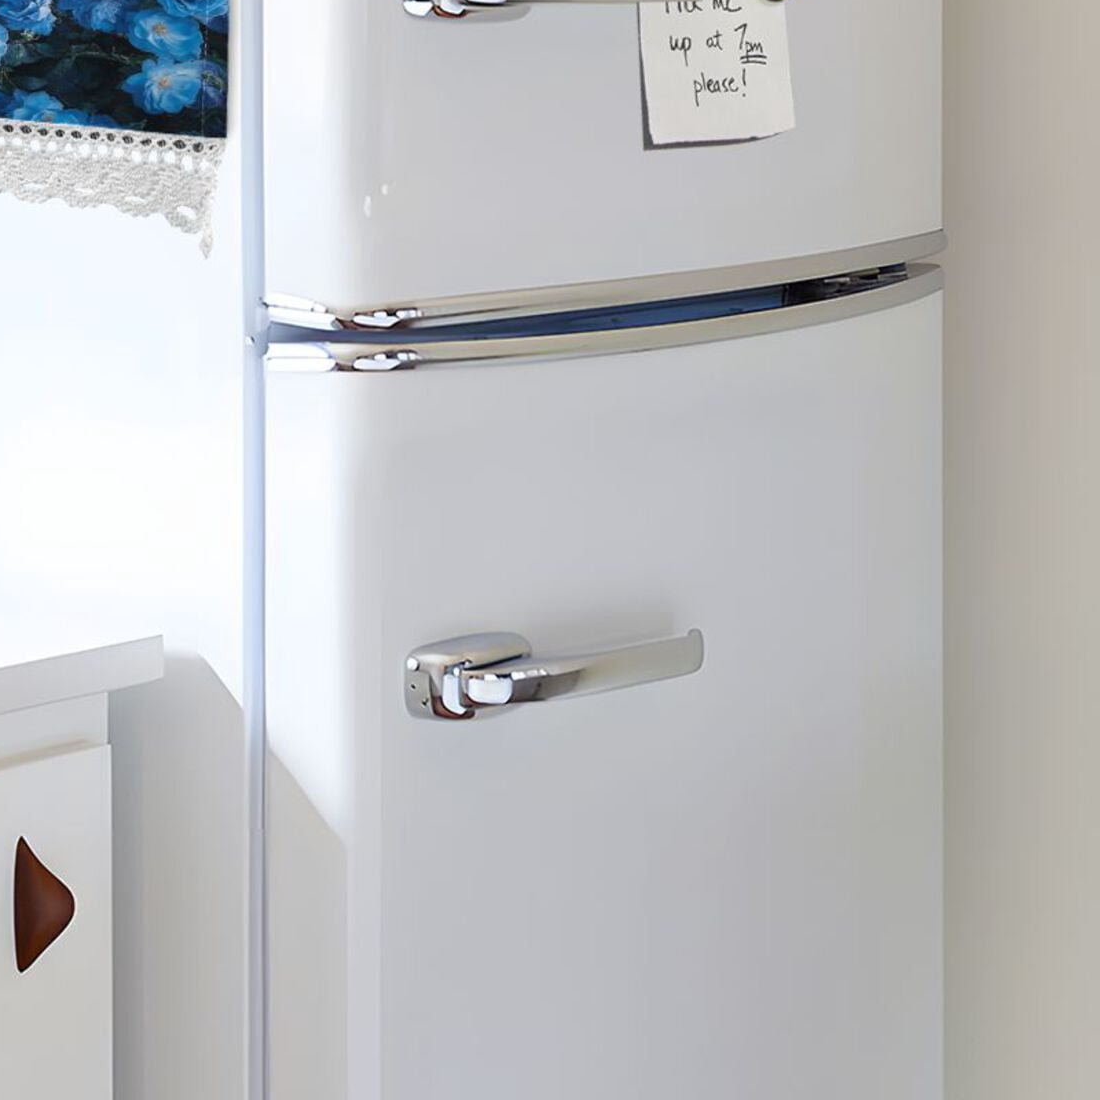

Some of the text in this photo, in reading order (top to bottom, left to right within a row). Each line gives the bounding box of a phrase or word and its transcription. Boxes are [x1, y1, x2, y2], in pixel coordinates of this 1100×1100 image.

[669, 35, 692, 67] up
[706, 29, 723, 51] at
[693, 68, 747, 107] please!
